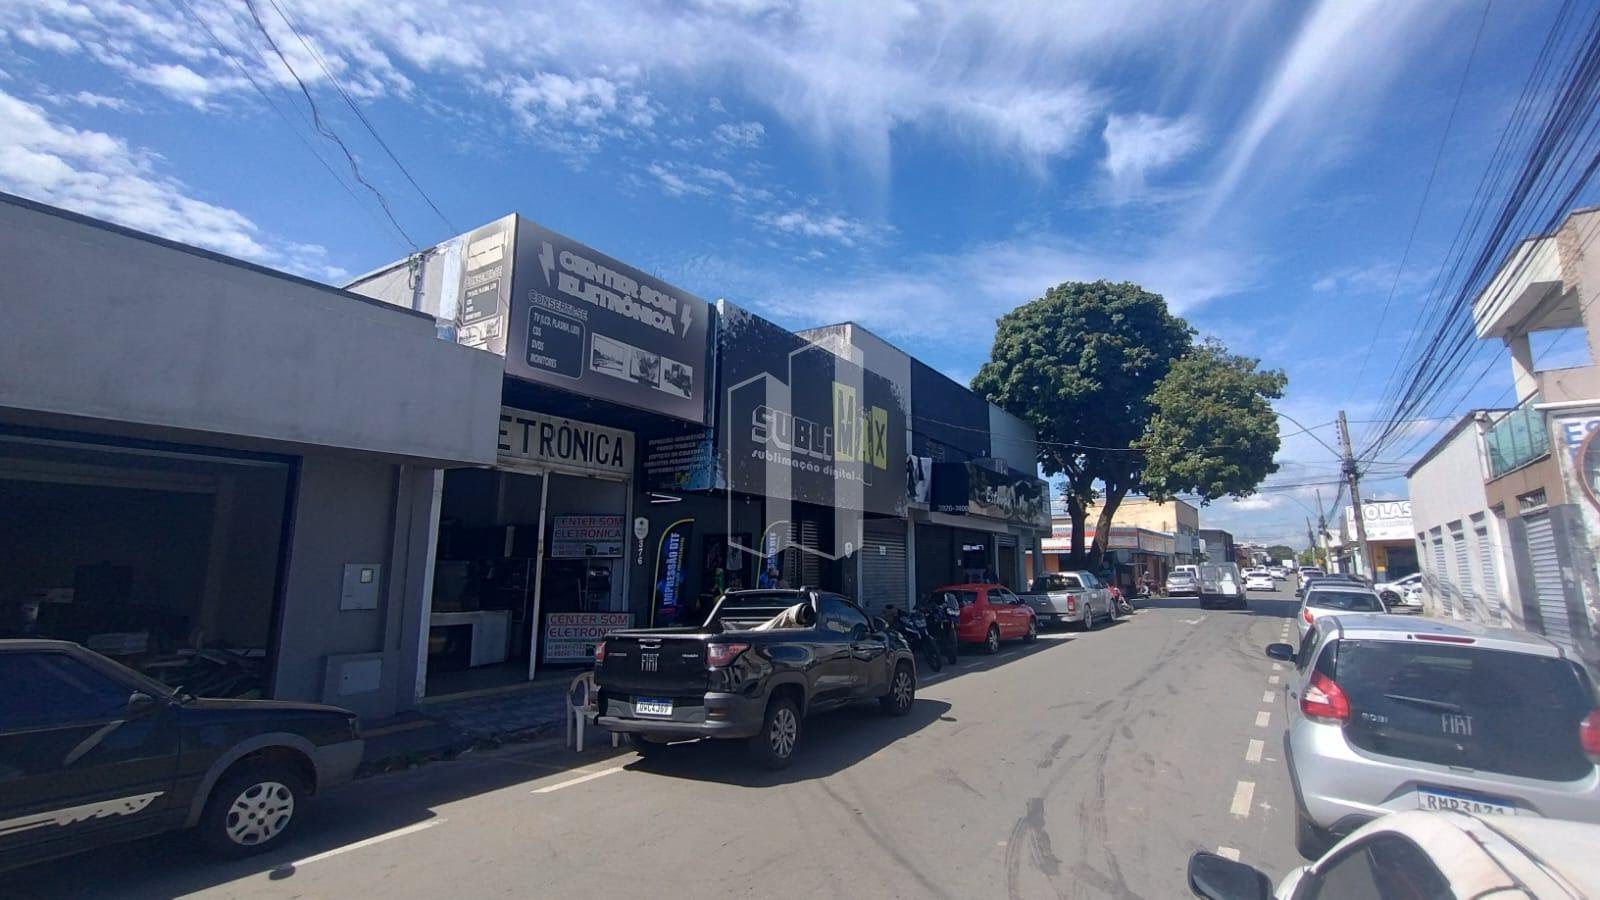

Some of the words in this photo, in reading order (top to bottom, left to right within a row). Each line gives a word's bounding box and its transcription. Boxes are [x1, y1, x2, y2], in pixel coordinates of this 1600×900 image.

[559, 250, 639, 299] CENTER
[639, 285, 678, 315] SOM
[534, 312, 540, 322] TV
[751, 450, 820, 472] sublimação
[823, 465, 855, 481] digital
[600, 517, 624, 527] SOM
[669, 532, 680, 550] DTF
[550, 614, 596, 625] CENTER
[601, 614, 628, 625] SOM
[641, 653, 659, 672] FIAT
[1441, 712, 1473, 737] FIAT
